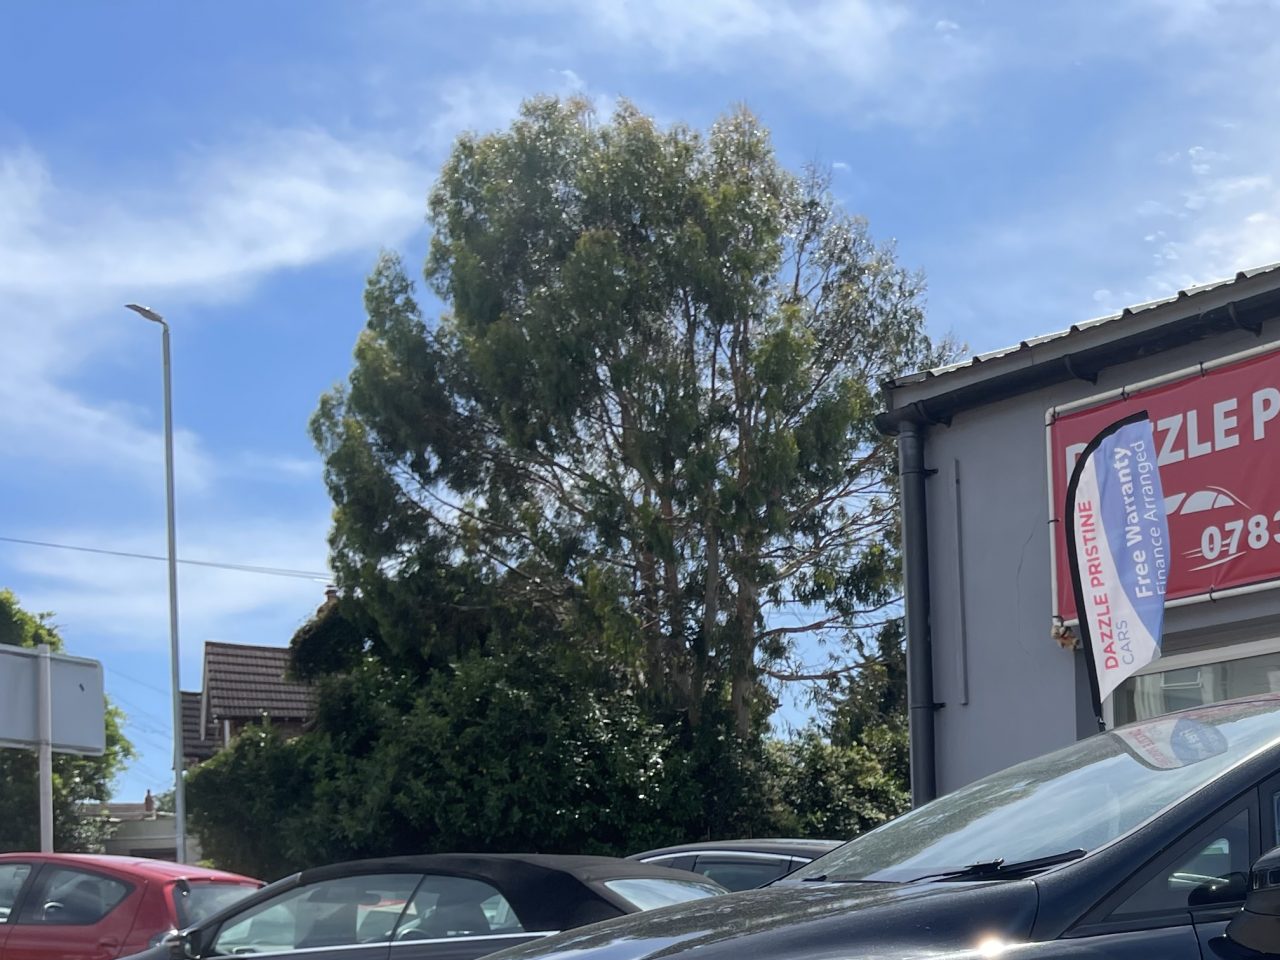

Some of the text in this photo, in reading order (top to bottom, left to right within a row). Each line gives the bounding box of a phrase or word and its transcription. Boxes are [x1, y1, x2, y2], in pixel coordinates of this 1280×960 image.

[1066, 397, 1240, 487] ZLE
[1130, 440, 1166, 595] Finance Arranged
[1078, 500, 1119, 670] DAZZLE PRISTINE
[1113, 446, 1154, 598] Free Warranty
[1115, 619, 1134, 665] CARS
